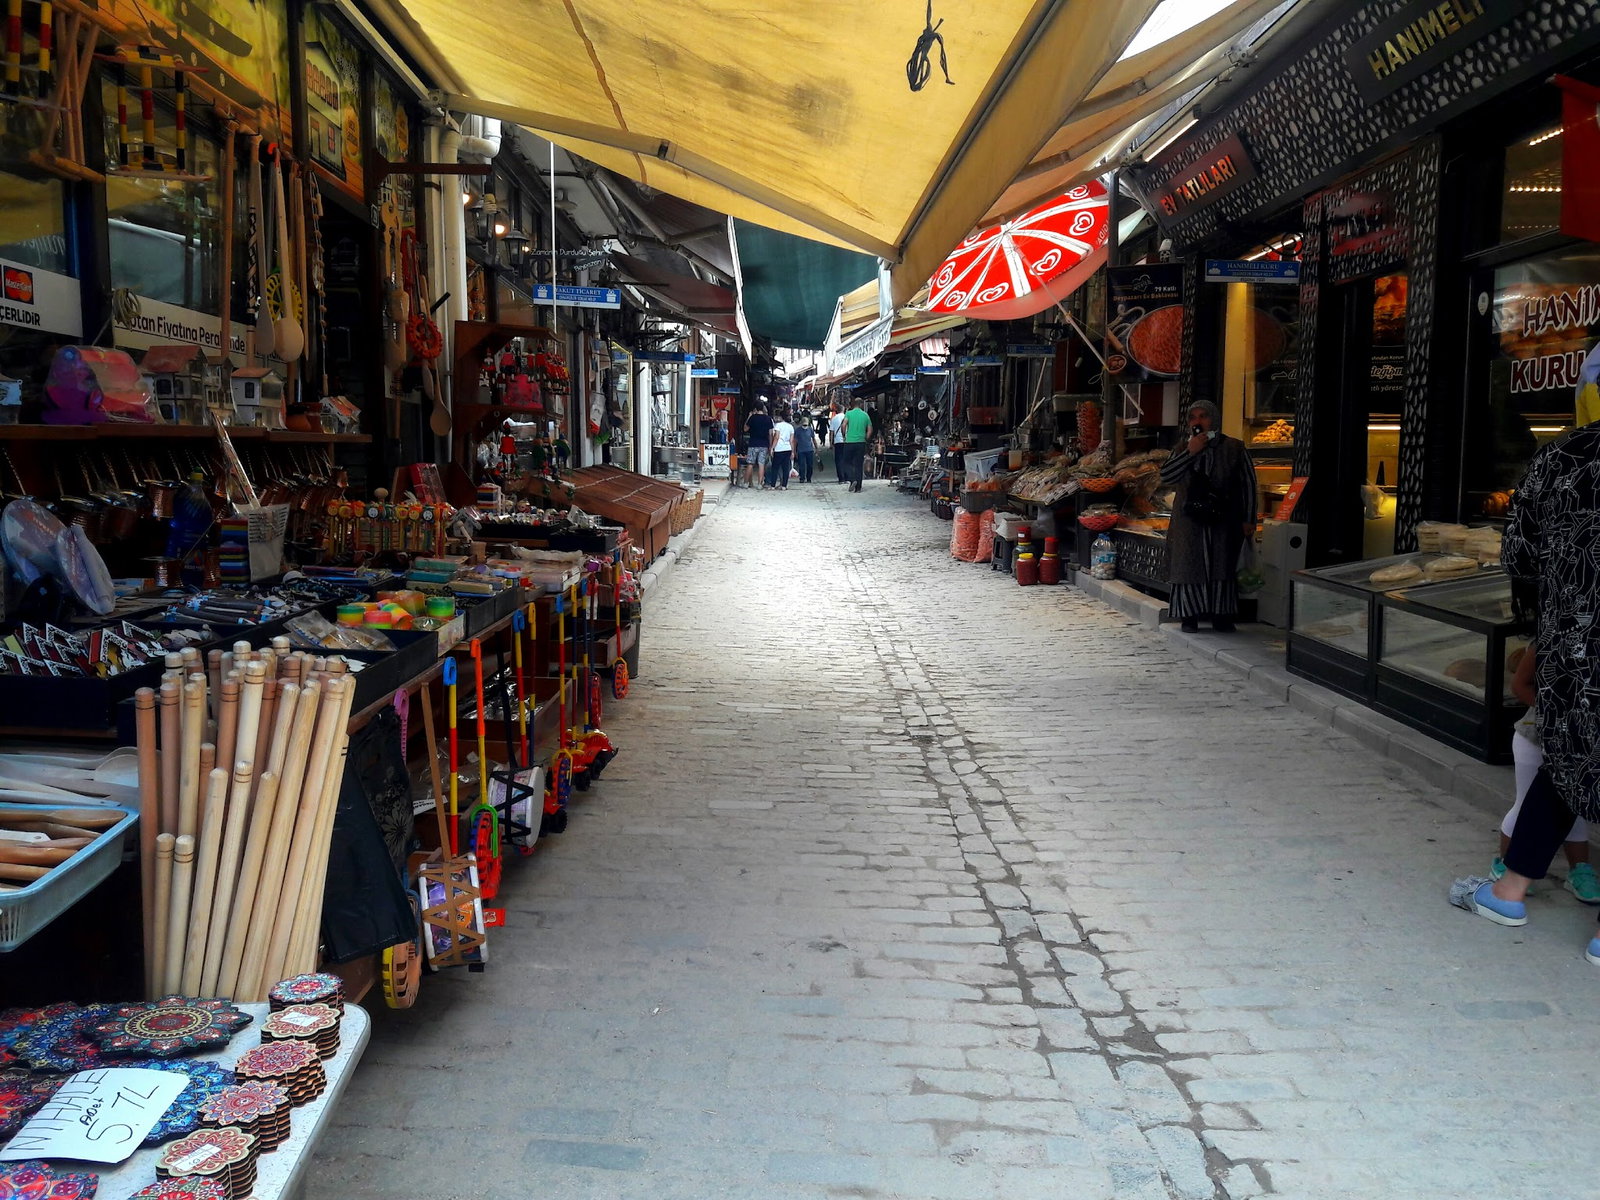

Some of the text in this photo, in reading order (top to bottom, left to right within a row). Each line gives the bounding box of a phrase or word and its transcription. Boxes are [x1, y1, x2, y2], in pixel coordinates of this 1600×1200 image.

[1160, 154, 1238, 217] EV TATLILARI
[157, 316, 197, 342] Fiyatına
[1510, 350, 1586, 393] KURU
